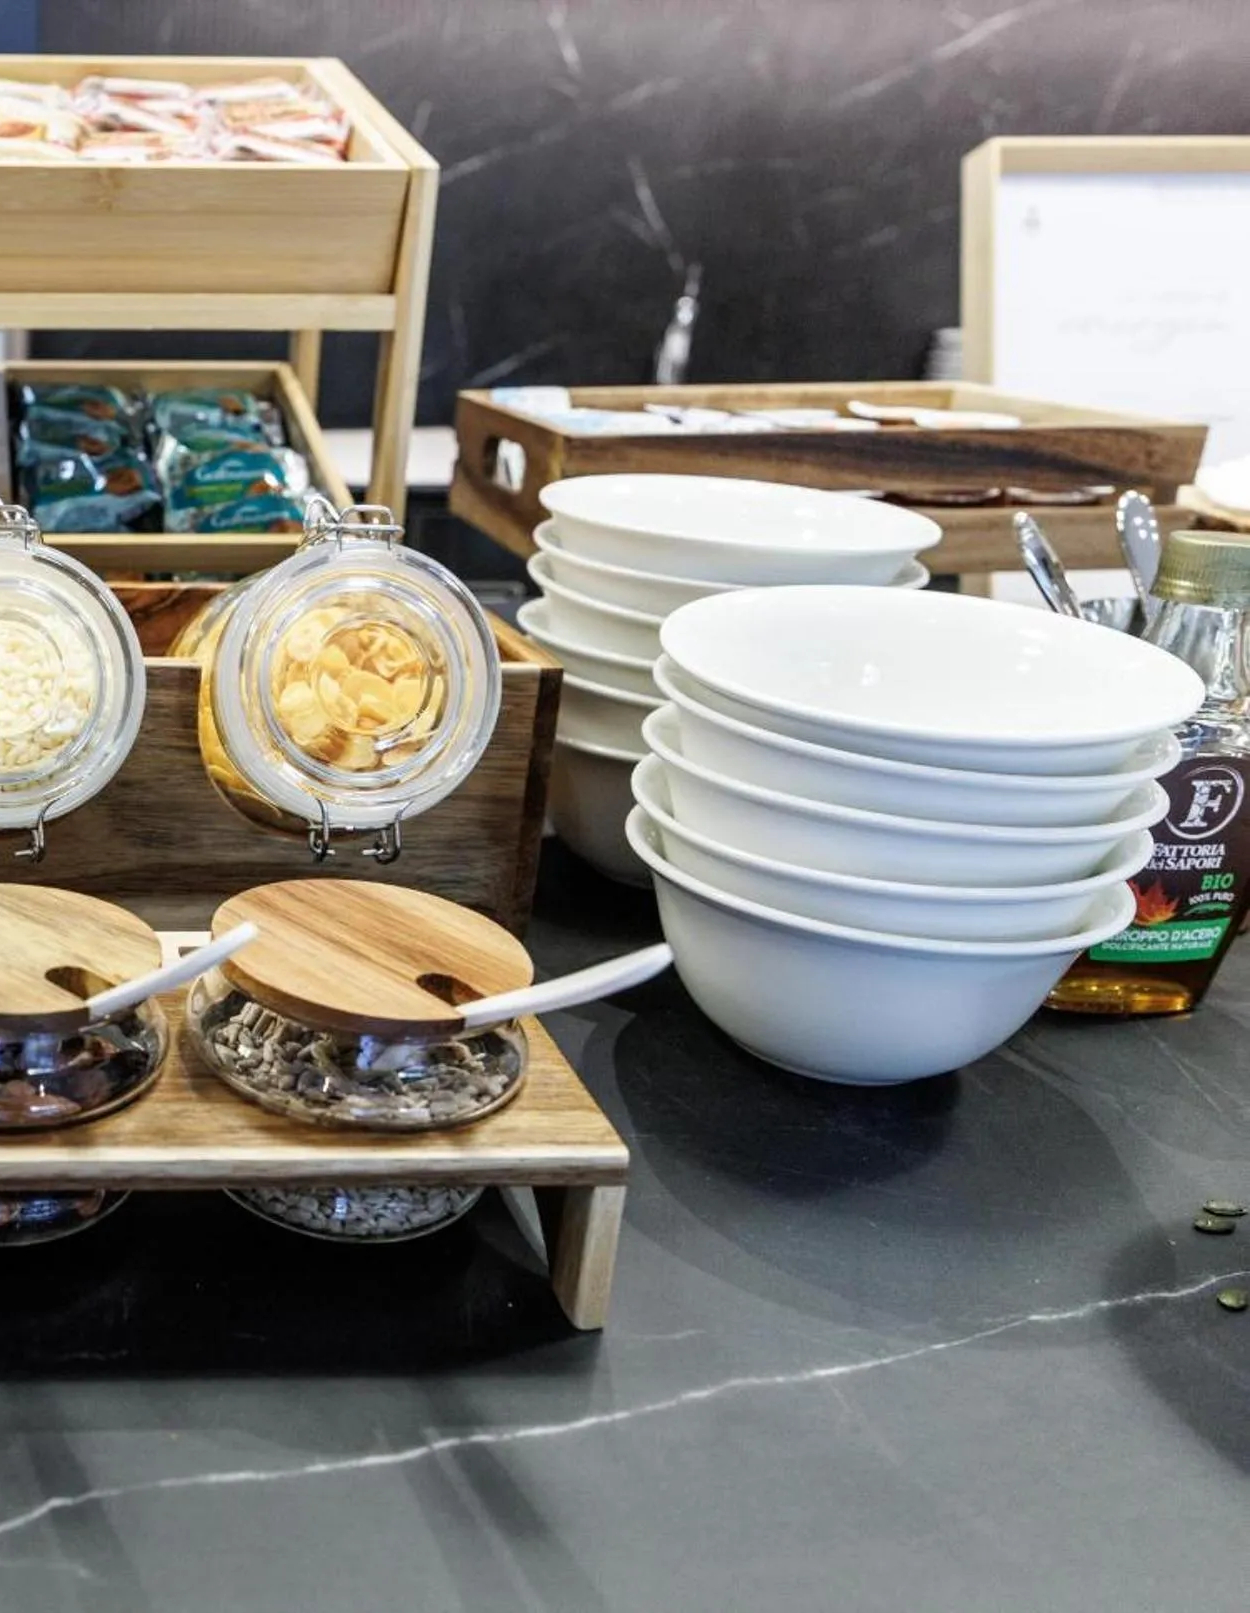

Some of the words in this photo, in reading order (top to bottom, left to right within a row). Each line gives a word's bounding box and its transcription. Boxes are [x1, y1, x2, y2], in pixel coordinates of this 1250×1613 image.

[1179, 778, 1233, 828] F
[1153, 842, 1226, 858] FATTORIA
[1165, 856, 1223, 871] SAPORI
[1201, 873, 1235, 891] BIO
